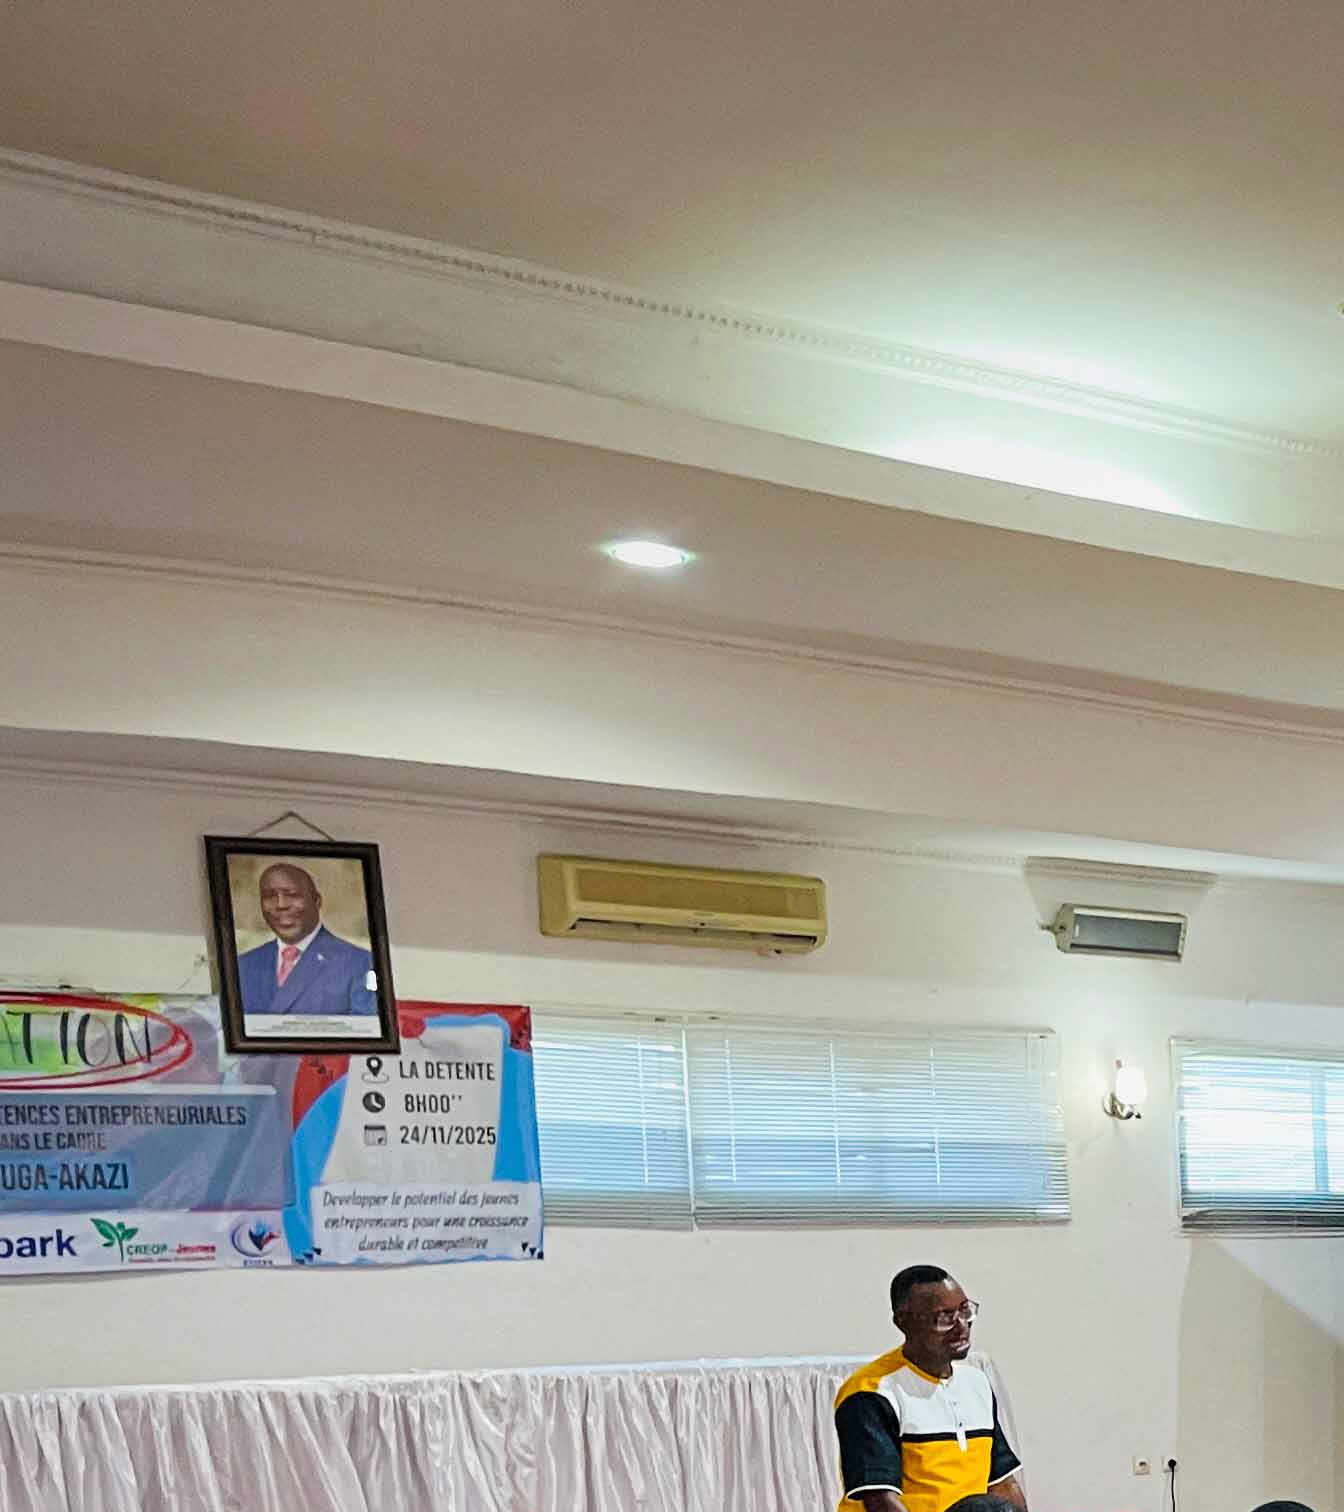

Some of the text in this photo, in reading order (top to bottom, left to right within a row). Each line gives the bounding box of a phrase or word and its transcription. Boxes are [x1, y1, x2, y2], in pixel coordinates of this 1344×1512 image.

[399, 1061, 496, 1081] LA DETENTE
[65, 1104, 247, 1126] ENTREPRENEURIALES
[399, 1125, 497, 1146] 24/11/2025
